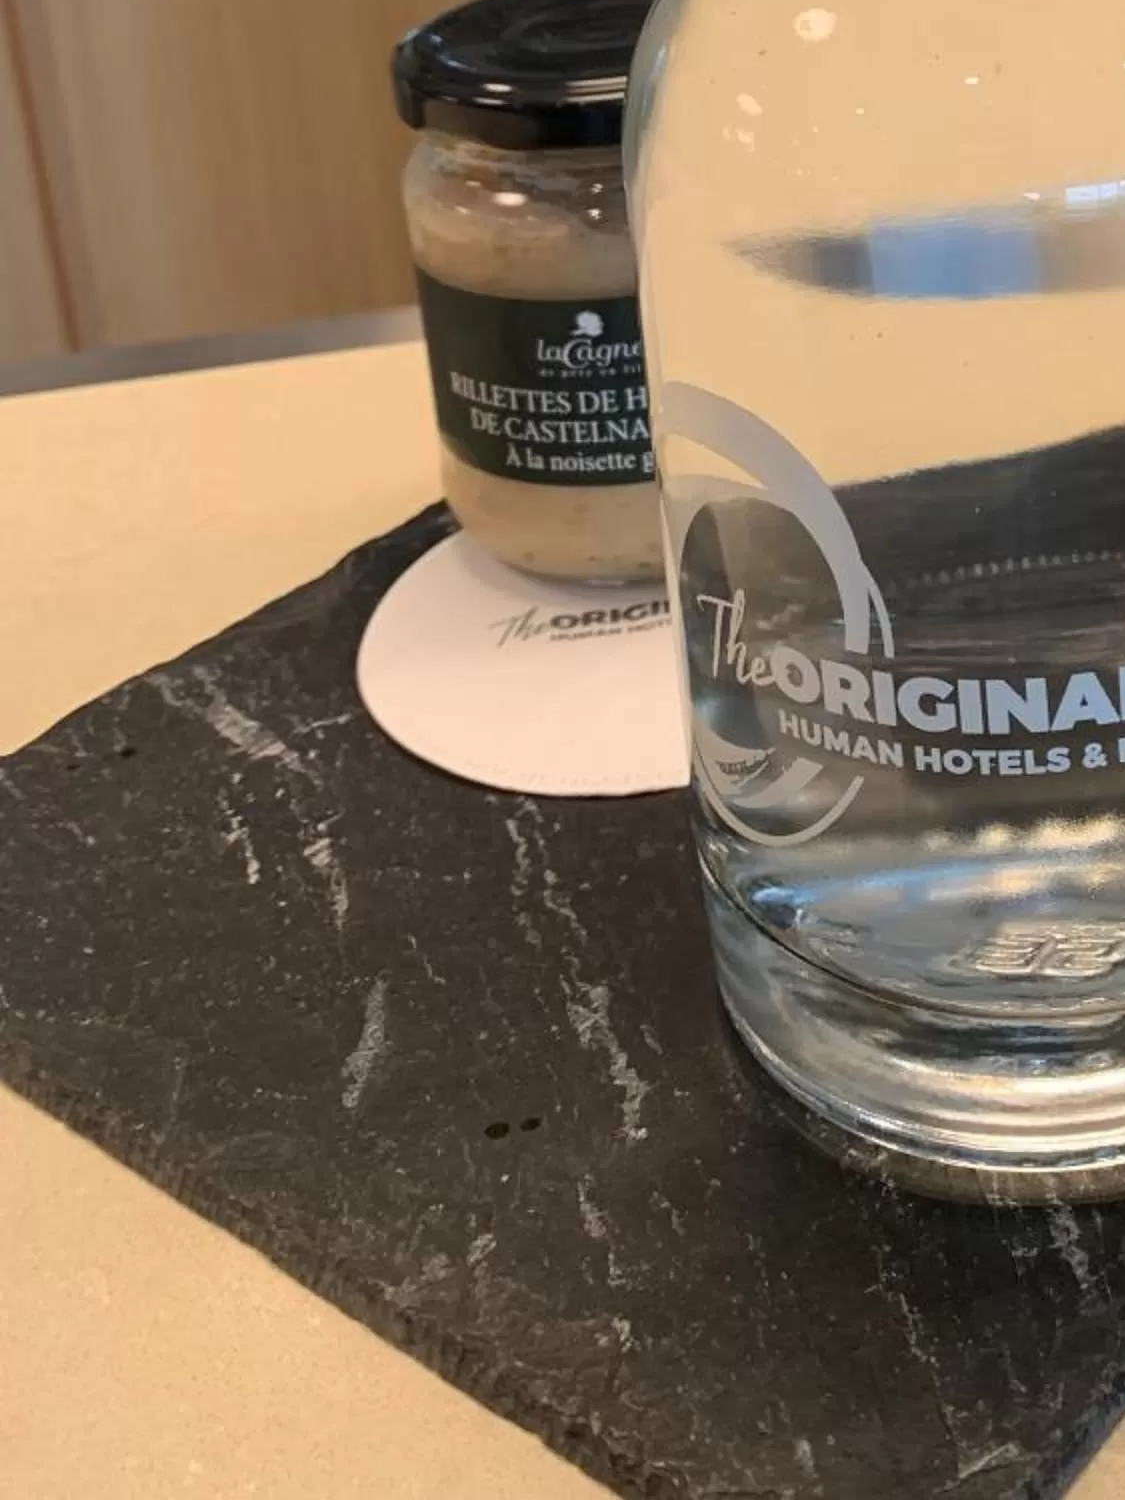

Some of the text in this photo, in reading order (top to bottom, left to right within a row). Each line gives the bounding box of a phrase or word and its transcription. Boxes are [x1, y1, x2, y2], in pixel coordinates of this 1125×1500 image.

[450, 371, 572, 414] RILLETTES
[576, 390, 620, 414] DE
[469, 407, 650, 444] DE CASTELNA
[526, 449, 545, 470] la
[549, 450, 637, 472] noisette
[697, 588, 775, 686] The
[777, 708, 904, 769] HUMAN
[914, 745, 1072, 776] HOTELS
[1081, 742, 1108, 768] &
